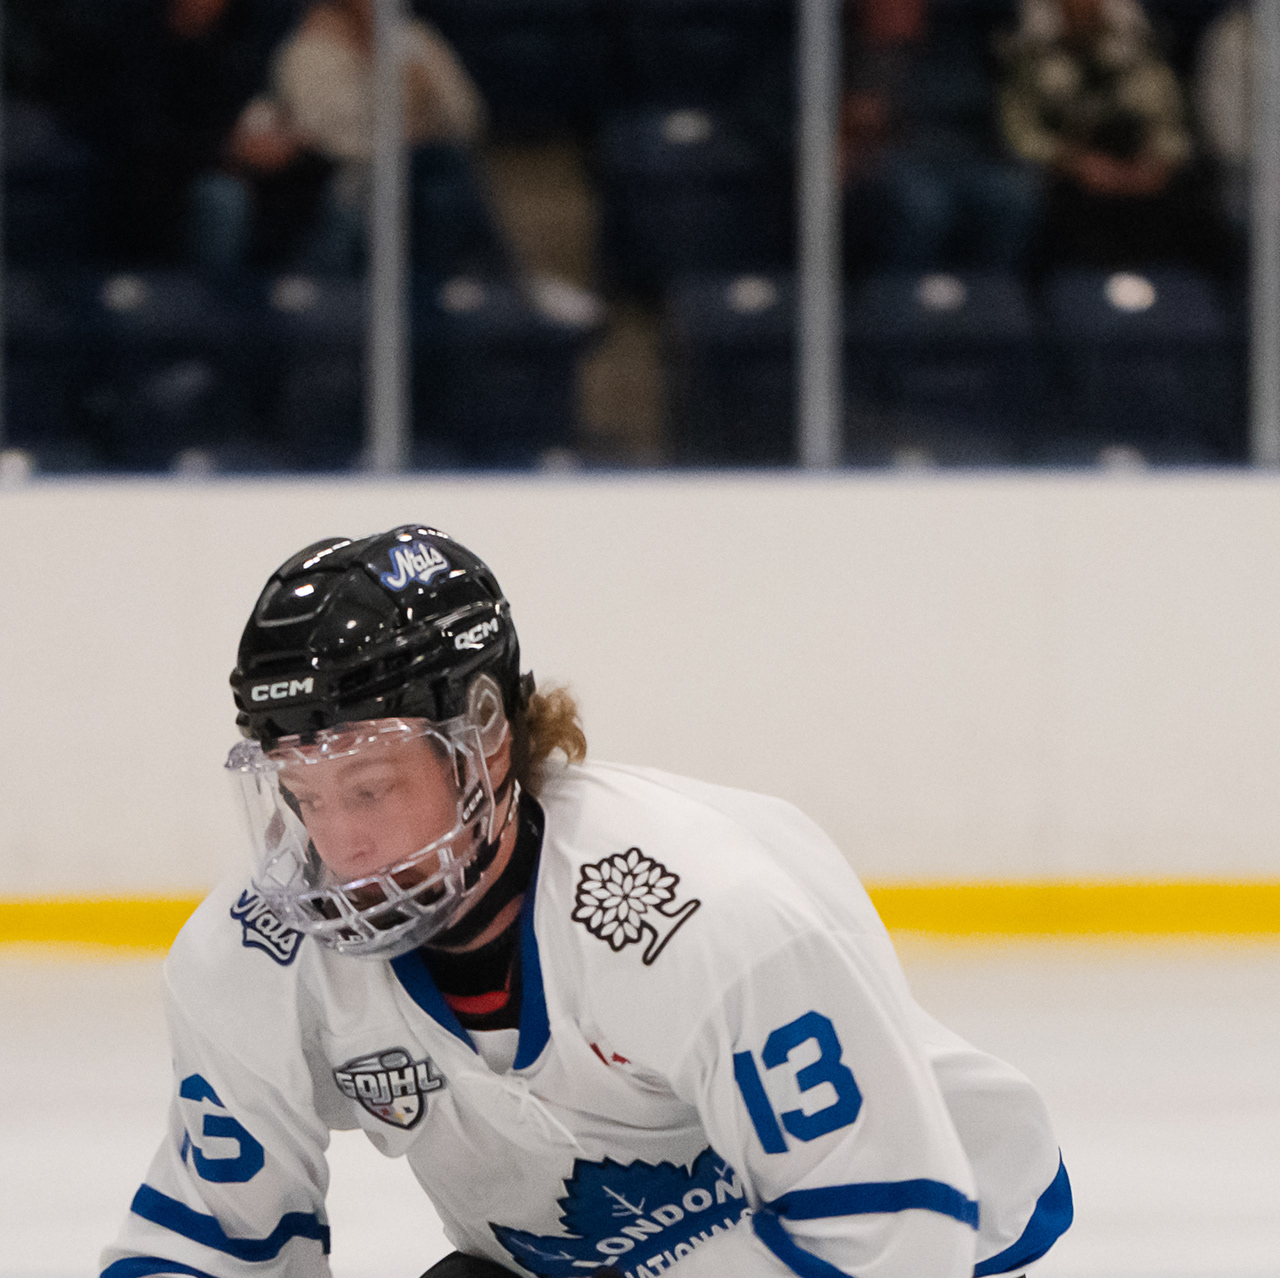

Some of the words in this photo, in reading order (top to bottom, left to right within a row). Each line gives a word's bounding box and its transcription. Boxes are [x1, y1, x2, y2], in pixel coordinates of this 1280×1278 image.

[251, 677, 315, 702] CCM
[179, 1072, 266, 1184] 3
[733, 1010, 864, 1155] 13
[572, 1174, 745, 1268] LONDON
